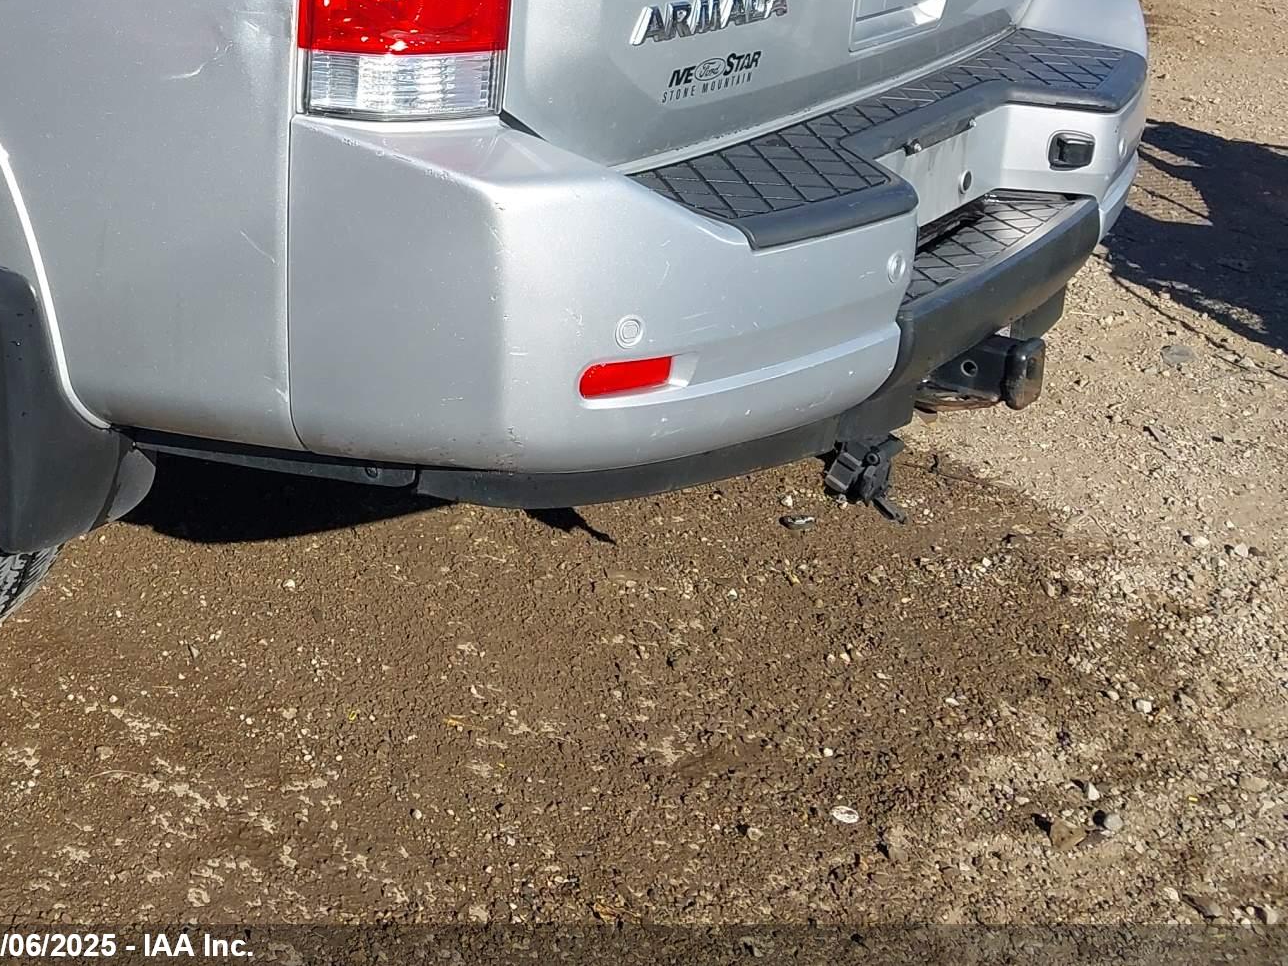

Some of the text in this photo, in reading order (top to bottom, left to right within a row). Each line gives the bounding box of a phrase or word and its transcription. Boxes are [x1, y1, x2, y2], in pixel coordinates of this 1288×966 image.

[697, 60, 724, 80] Ford
[723, 50, 762, 76] STAR
[662, 71, 753, 103] STONE MOUNTAIN
